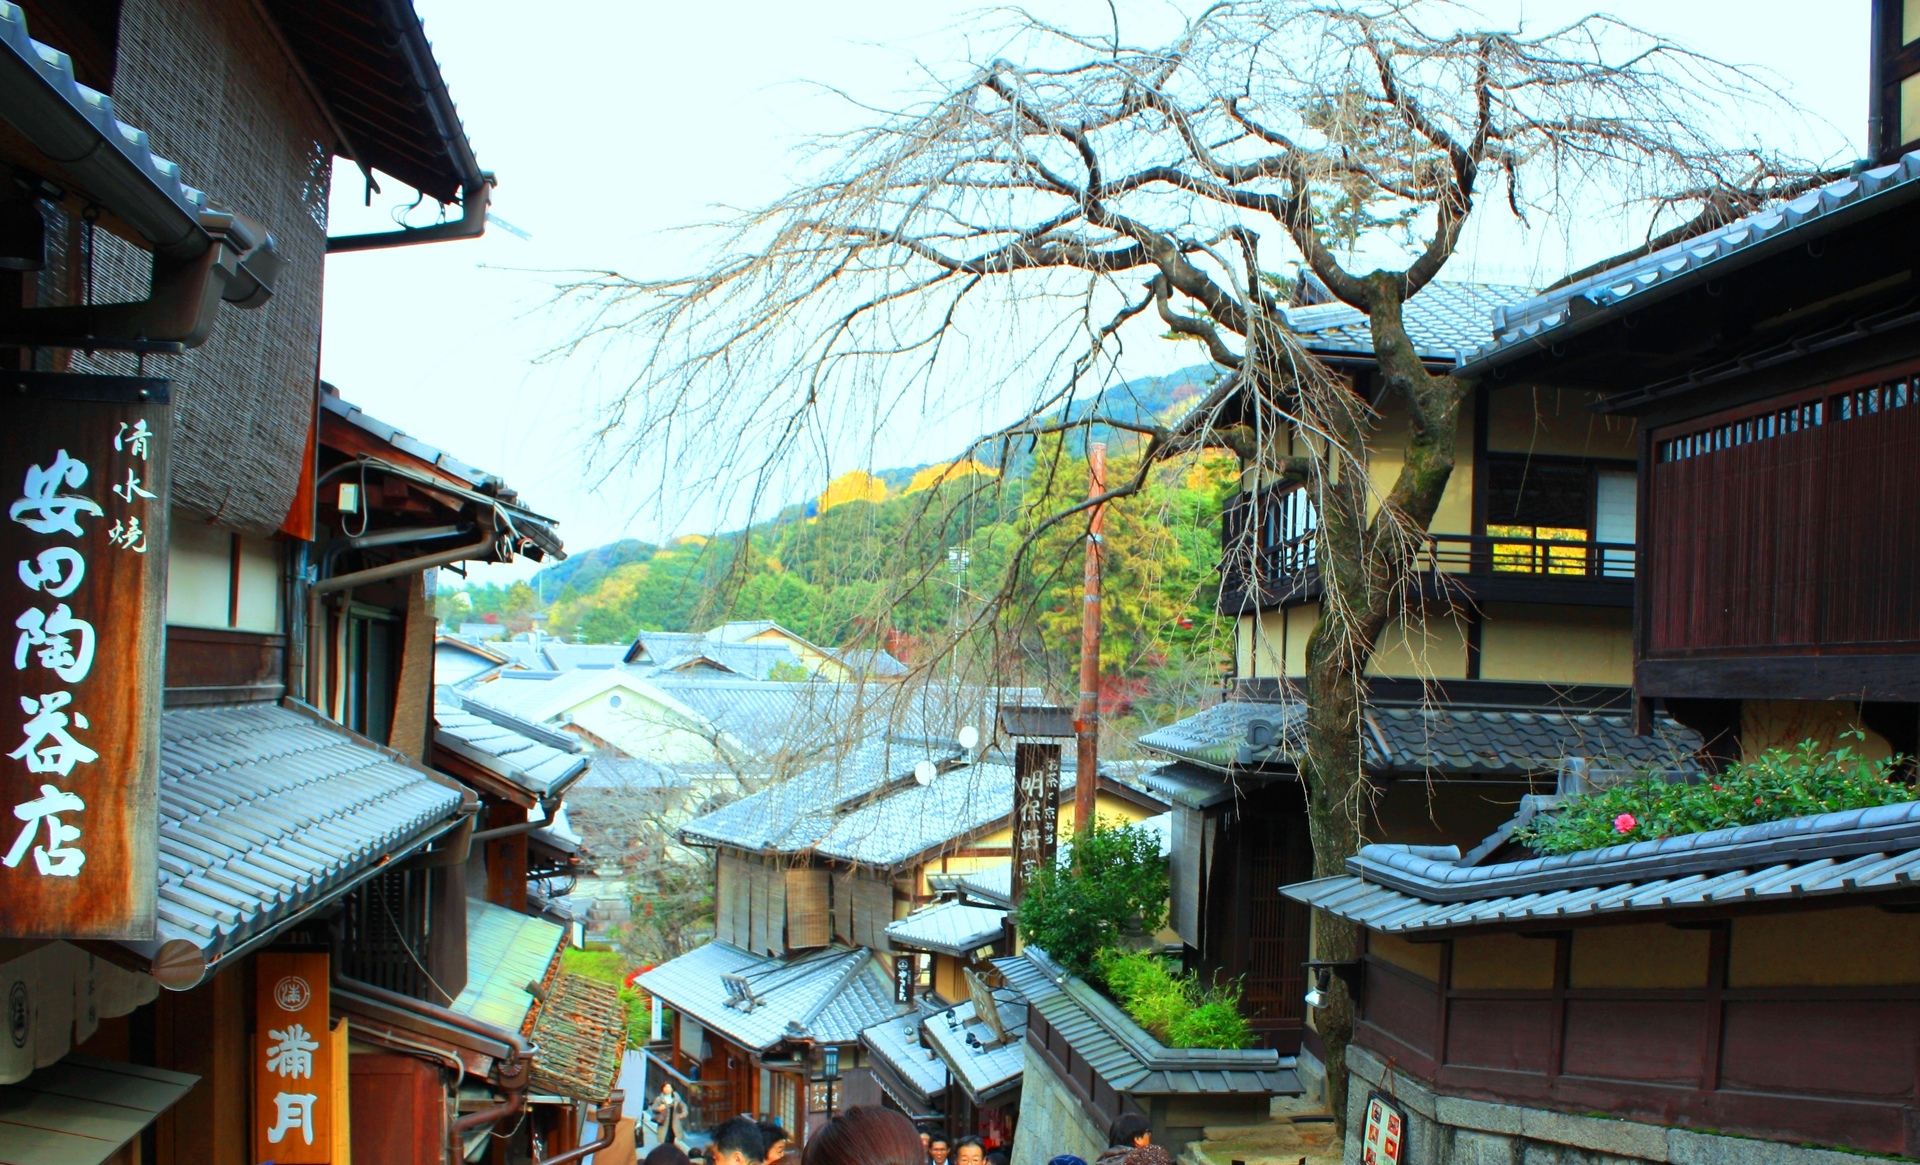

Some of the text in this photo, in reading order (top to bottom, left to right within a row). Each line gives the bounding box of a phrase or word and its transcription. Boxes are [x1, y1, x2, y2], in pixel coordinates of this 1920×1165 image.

[1, 448, 105, 877] 安田陶器店
[1020, 771, 1044, 883] 明保野亭
